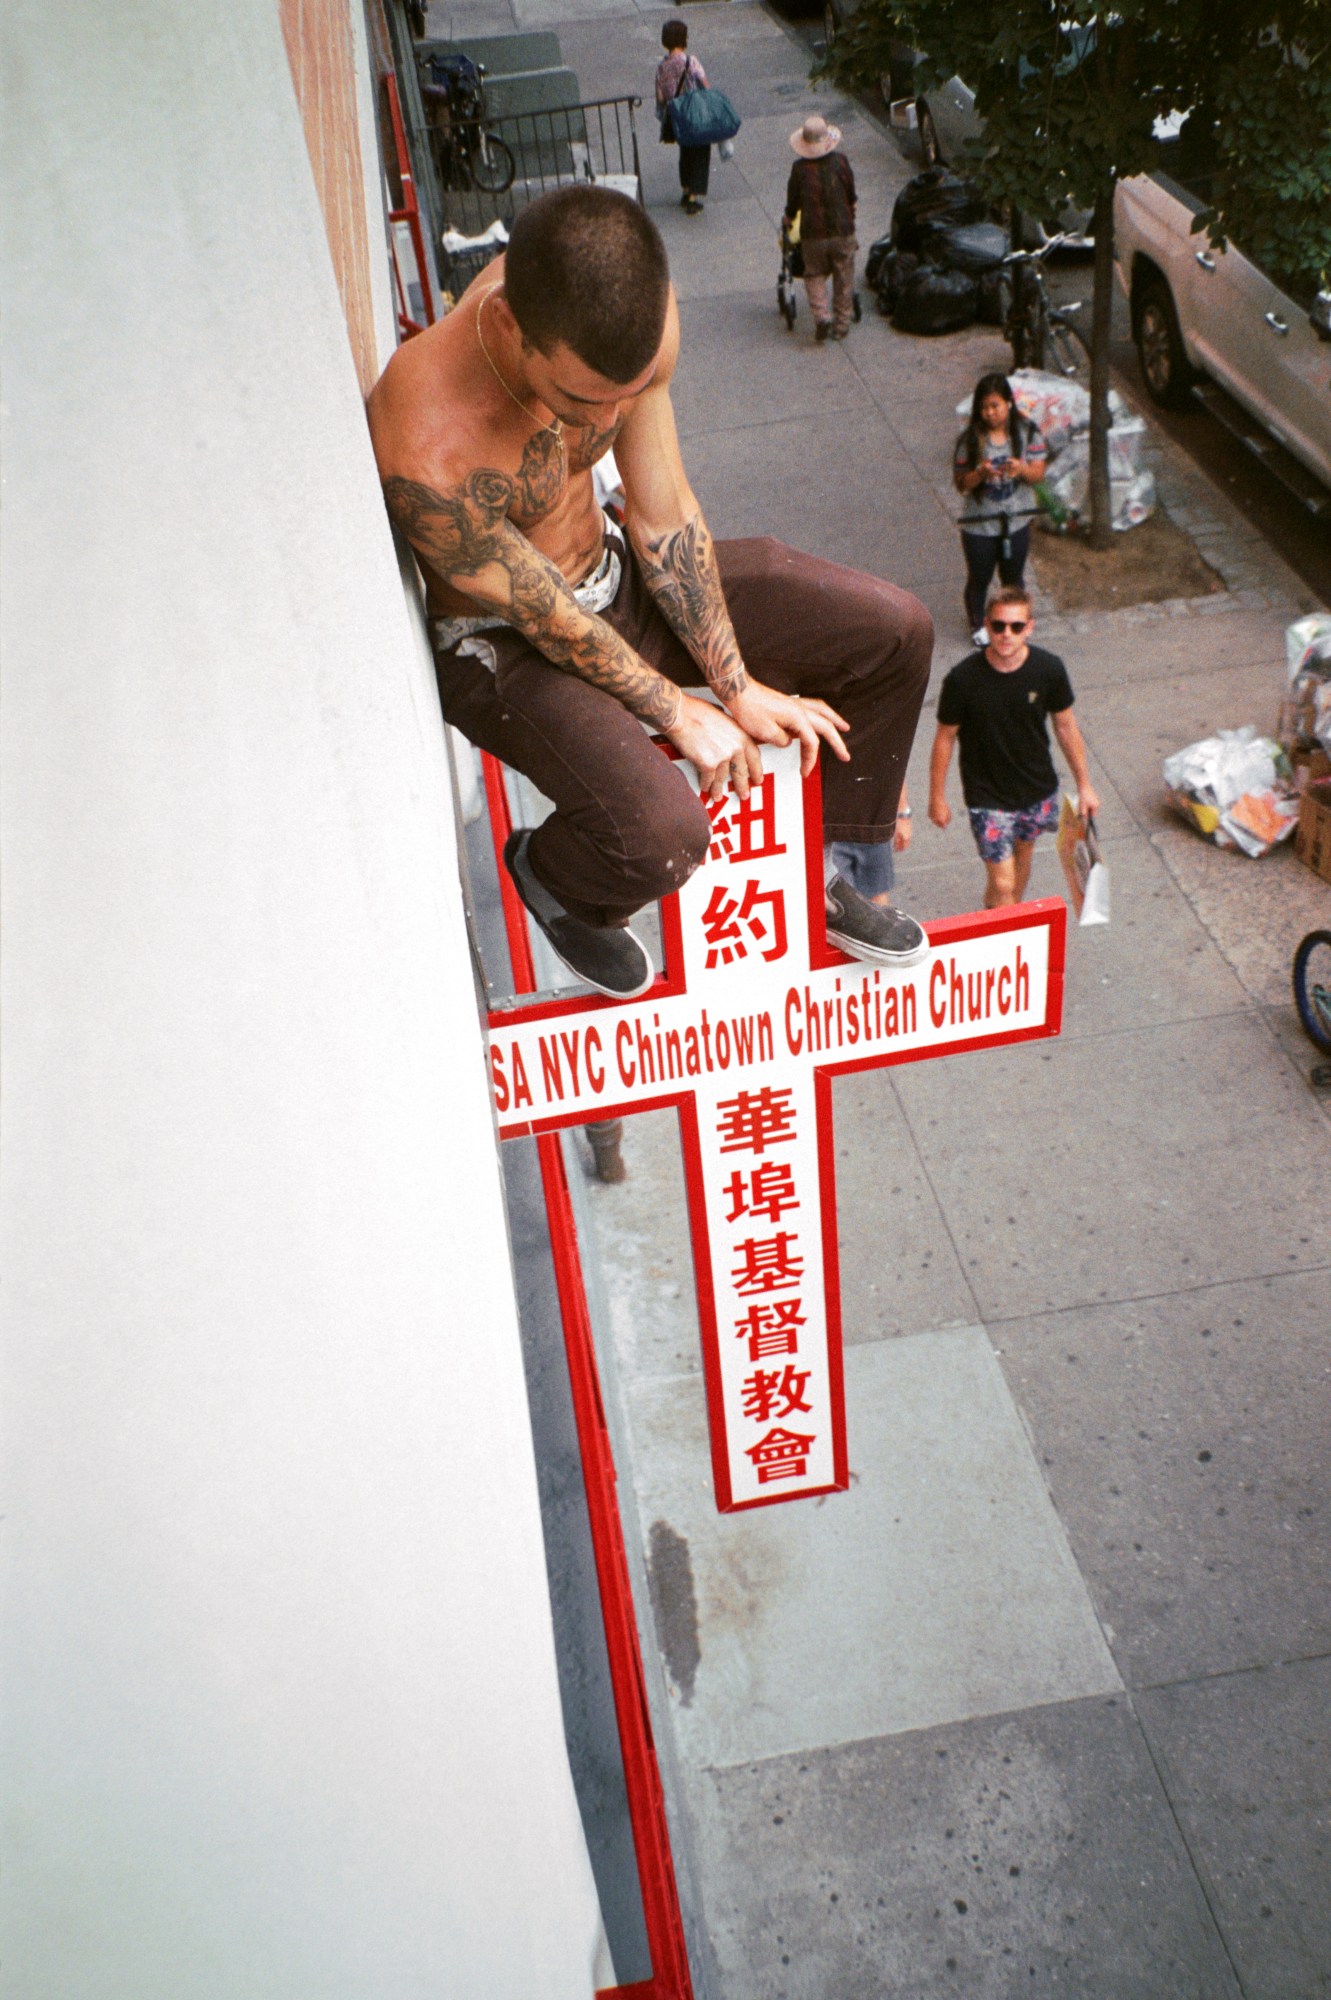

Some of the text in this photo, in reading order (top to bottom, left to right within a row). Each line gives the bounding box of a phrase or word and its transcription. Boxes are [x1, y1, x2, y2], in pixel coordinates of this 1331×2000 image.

[699, 772, 789, 969] 紐約
[538, 1026, 605, 1103] NYC
[616, 1009, 775, 1089] Chinatown
[785, 970, 917, 1057] Christian
[929, 946, 1030, 1028] Church
[715, 1086, 817, 1485] 華埠基督教會
